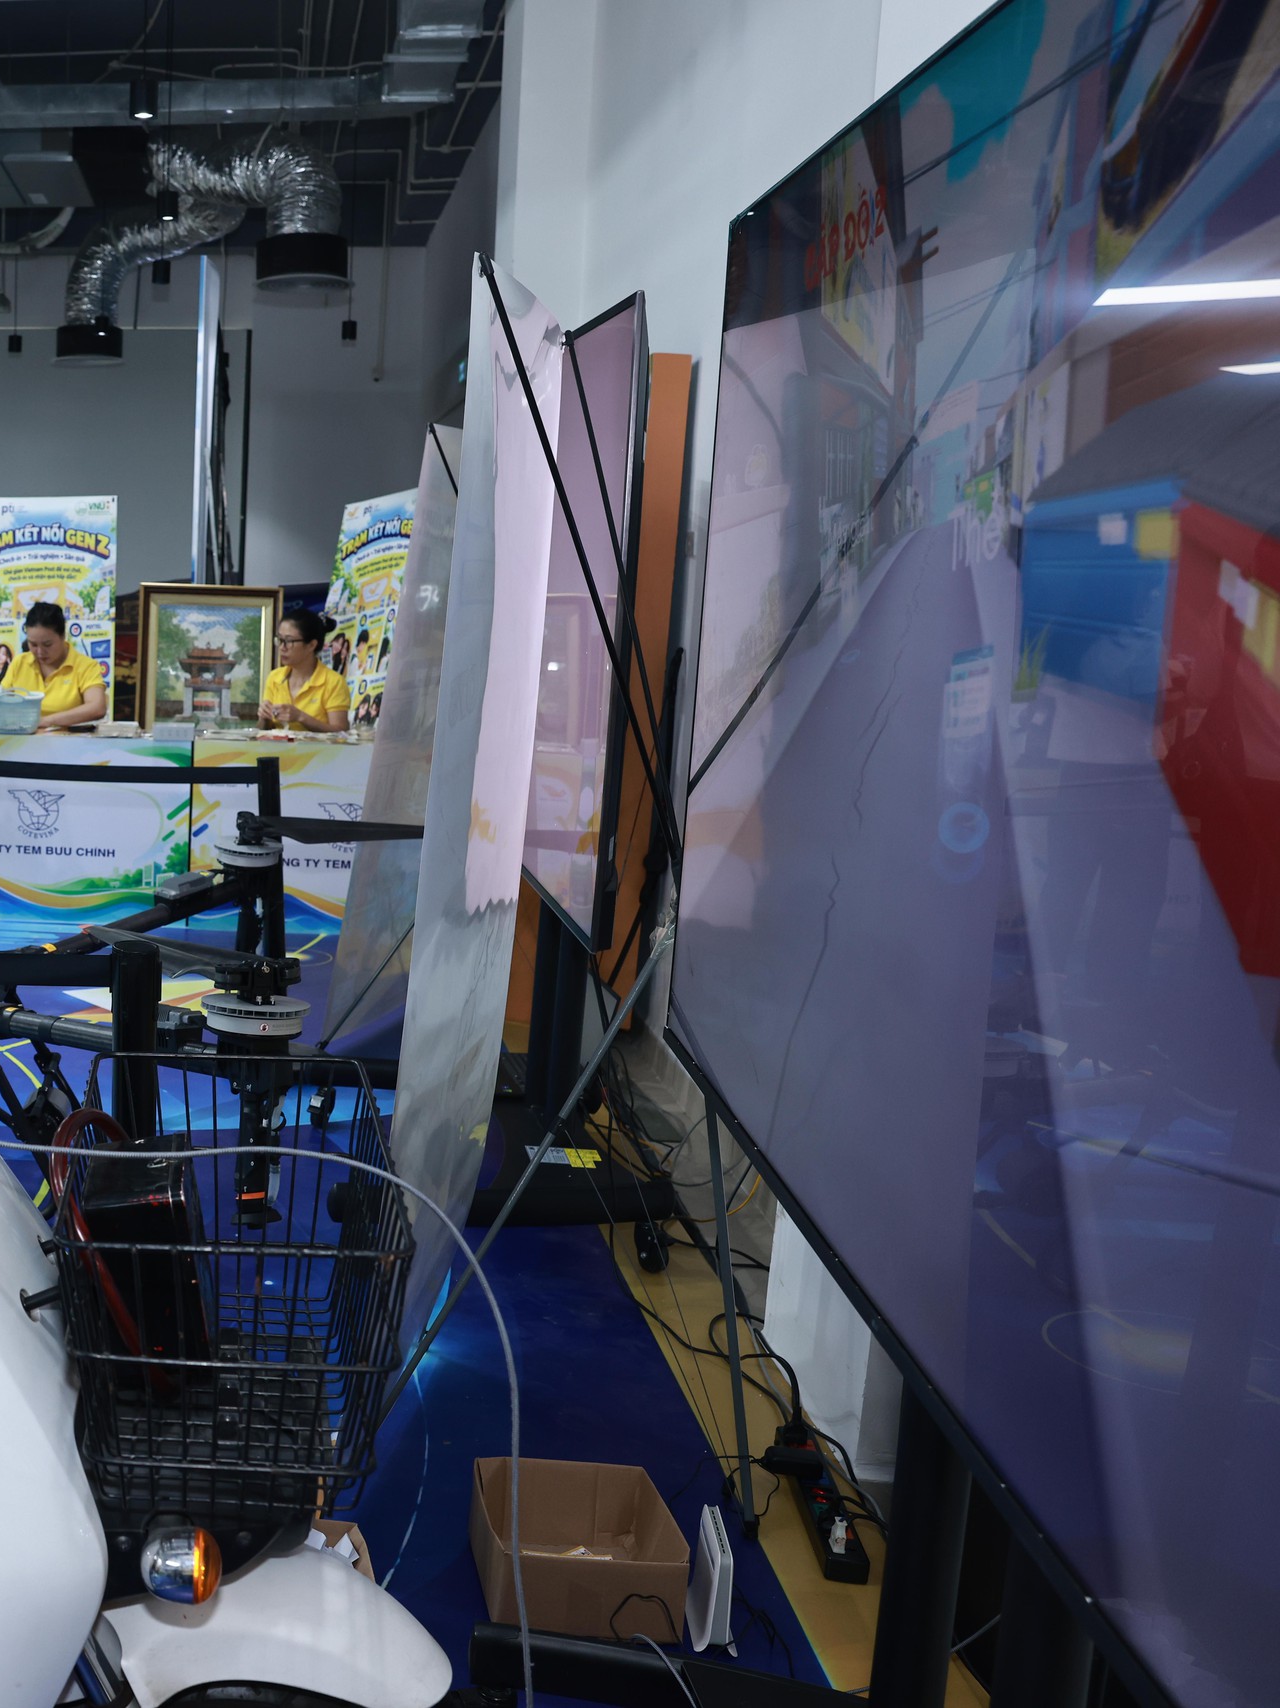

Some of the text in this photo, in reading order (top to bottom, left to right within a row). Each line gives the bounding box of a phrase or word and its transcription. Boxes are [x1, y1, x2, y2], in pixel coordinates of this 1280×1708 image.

[15, 523, 39, 543] KẾT
[41, 523, 64, 543] NỐI
[341, 516, 414, 560] TRẠM KẾT NỐI GE
[17, 825, 60, 839] COTEVINA
[16, 845, 42, 855] TEM
[282, 857, 351, 869] NG TY TEM
